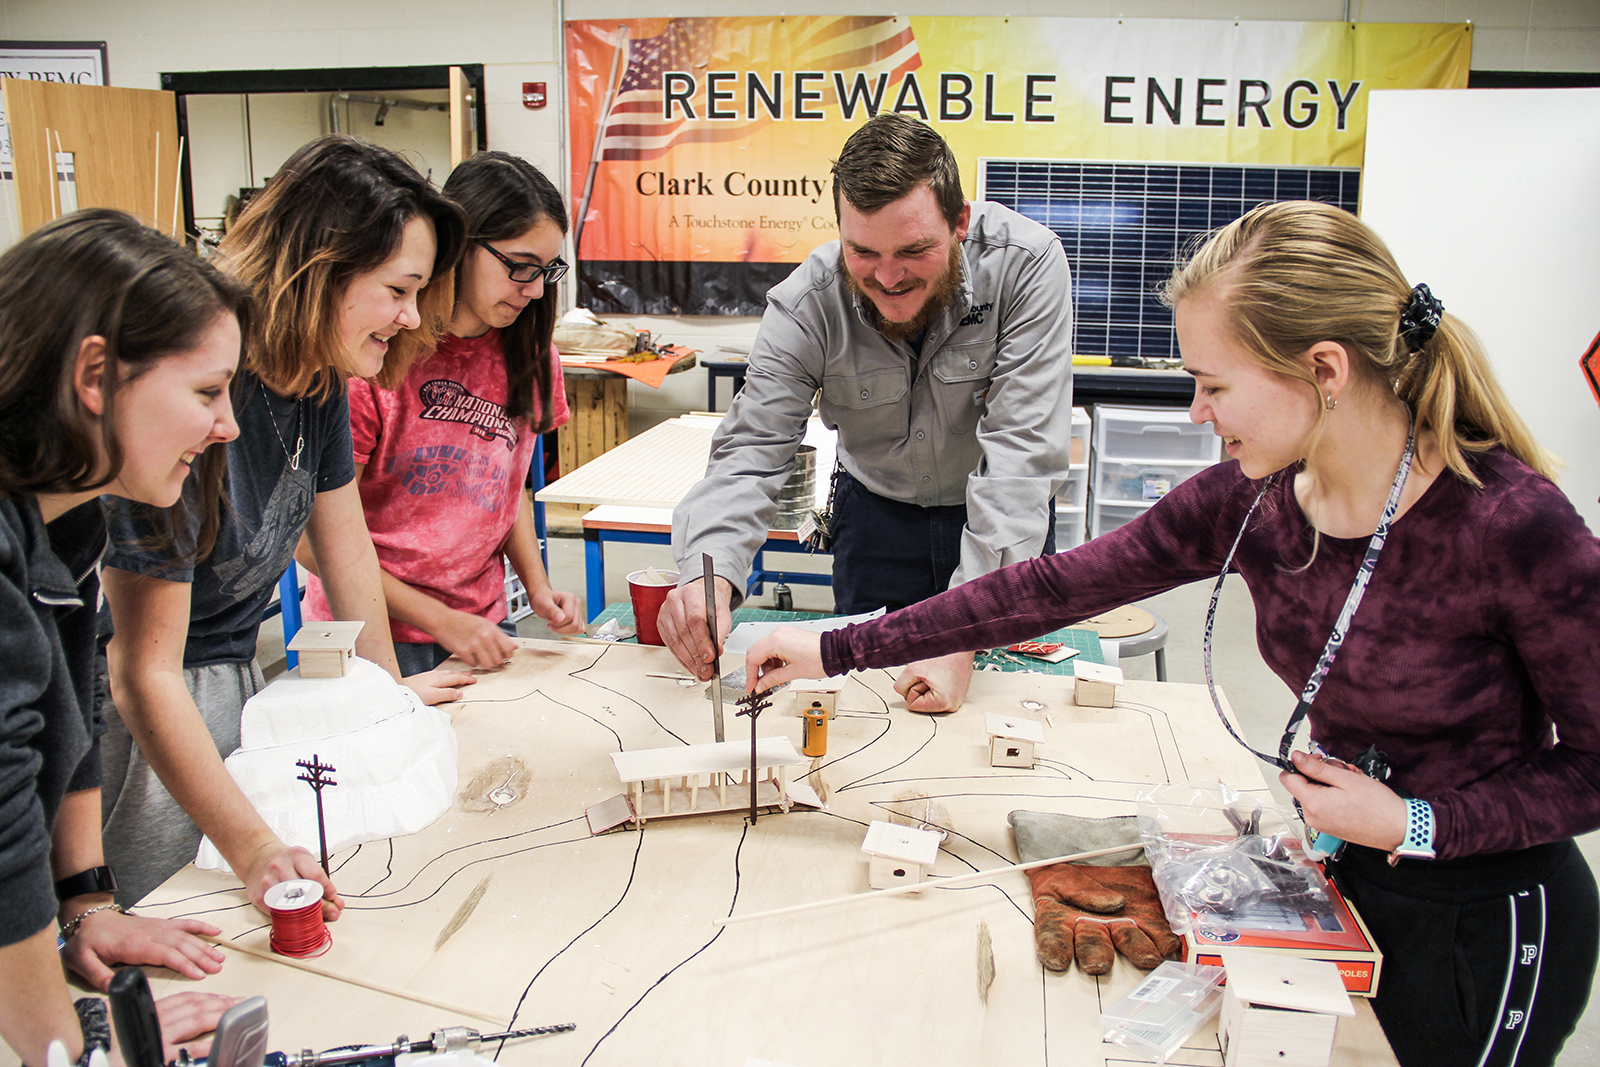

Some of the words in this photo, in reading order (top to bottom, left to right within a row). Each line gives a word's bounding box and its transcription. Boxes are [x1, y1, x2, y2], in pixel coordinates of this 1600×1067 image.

[662, 71, 1057, 124] RENEWABLE
[1102, 74, 1364, 131] ENERGY
[636, 171, 714, 196] Clark
[724, 171, 827, 204] County
[669, 215, 679, 229] A
[684, 214, 755, 229] Touchstone
[811, 215, 839, 230] Coo
[970, 302, 994, 312] ounty
[959, 312, 984, 326] EMC
[453, 394, 512, 421] NATIONA
[1521, 945, 1537, 965] P
[1339, 969, 1368, 978] POLES
[1505, 1011, 1523, 1029] P
